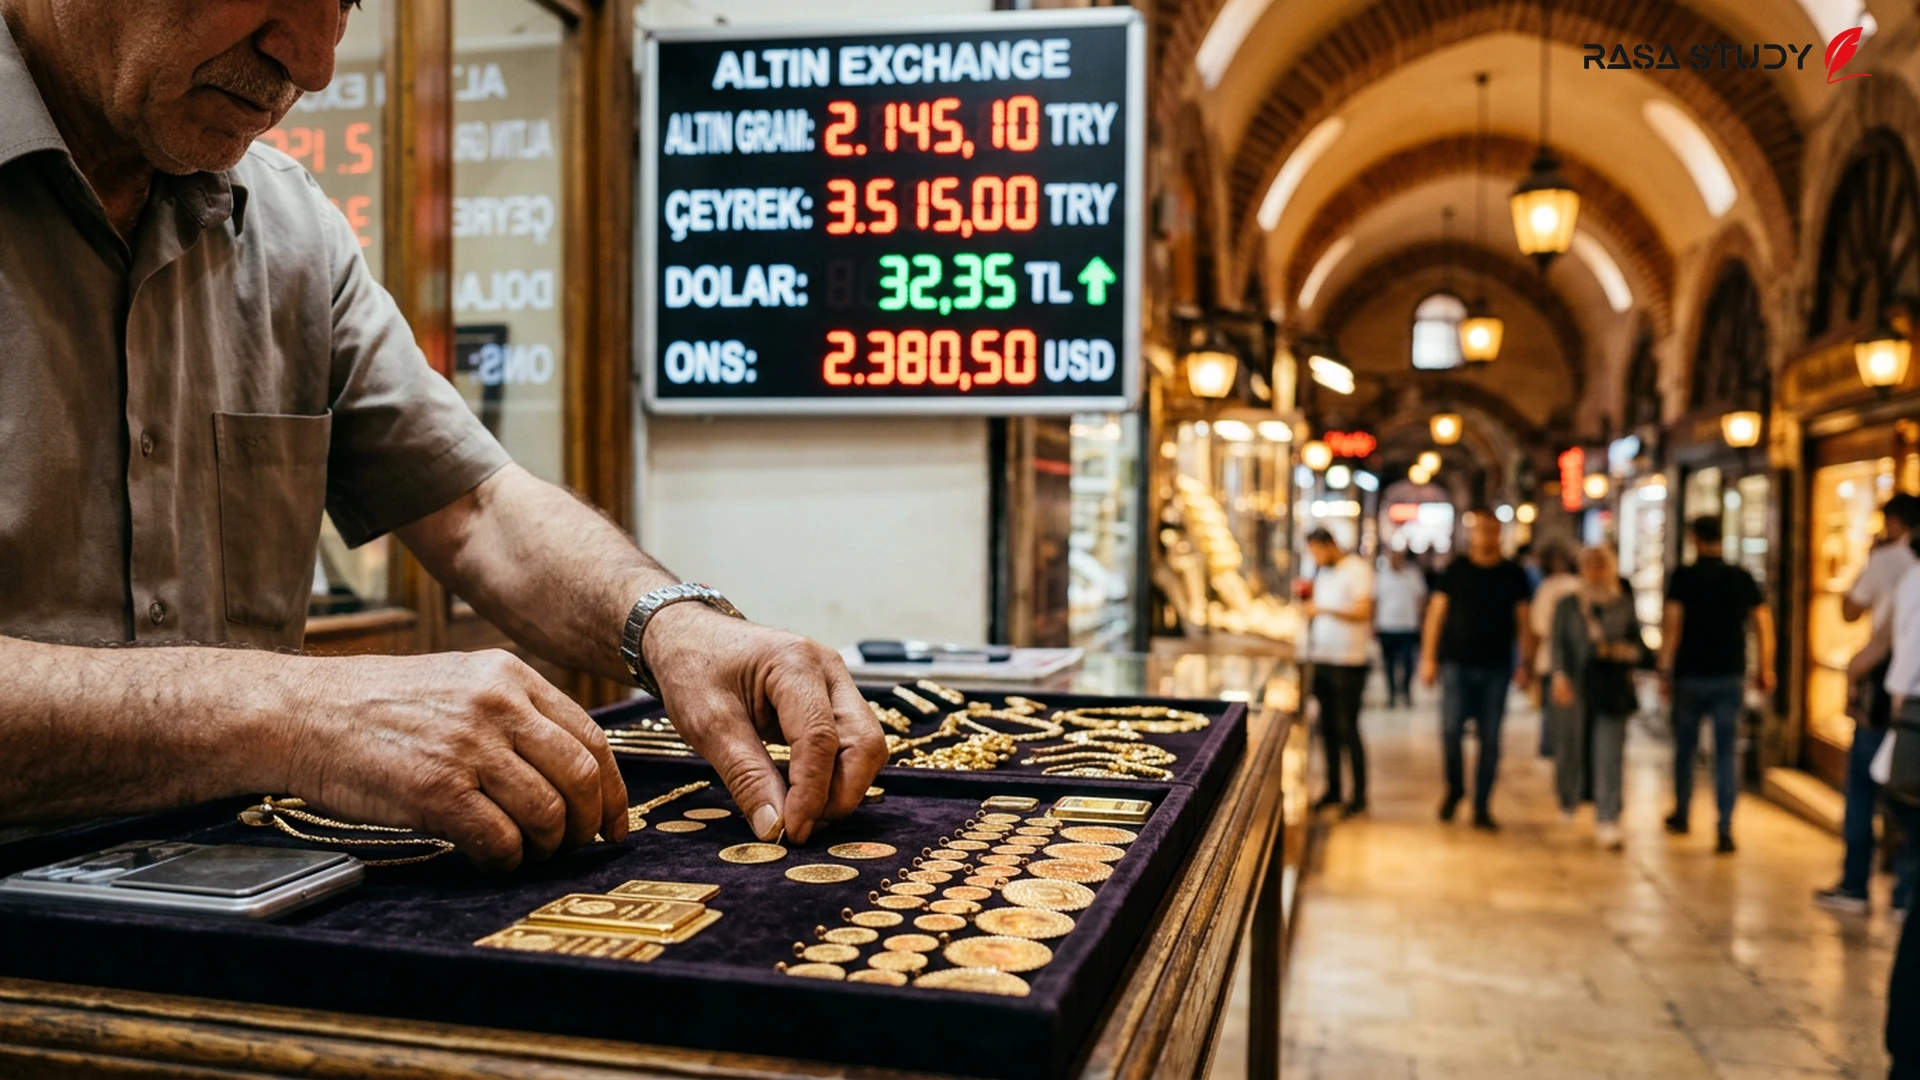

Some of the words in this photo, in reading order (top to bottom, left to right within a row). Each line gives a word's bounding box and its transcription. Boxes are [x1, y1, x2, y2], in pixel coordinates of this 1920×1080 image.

[712, 46, 831, 89] ALTIN
[838, 38, 1071, 86] EXCHANGE
[664, 111, 733, 155] ALTIN
[1045, 102, 1118, 146] TRY
[664, 187, 813, 241] ÇEYREK:
[826, 174, 1039, 238] 3.515,00
[1044, 183, 1117, 226] TRY
[665, 262, 808, 308] DOLAR:
[879, 253, 1016, 315] 32,35
[1024, 261, 1073, 303] TL
[664, 339, 757, 383] ONS:
[822, 329, 1037, 391] 2.380,50
[1044, 338, 1116, 382] USD
